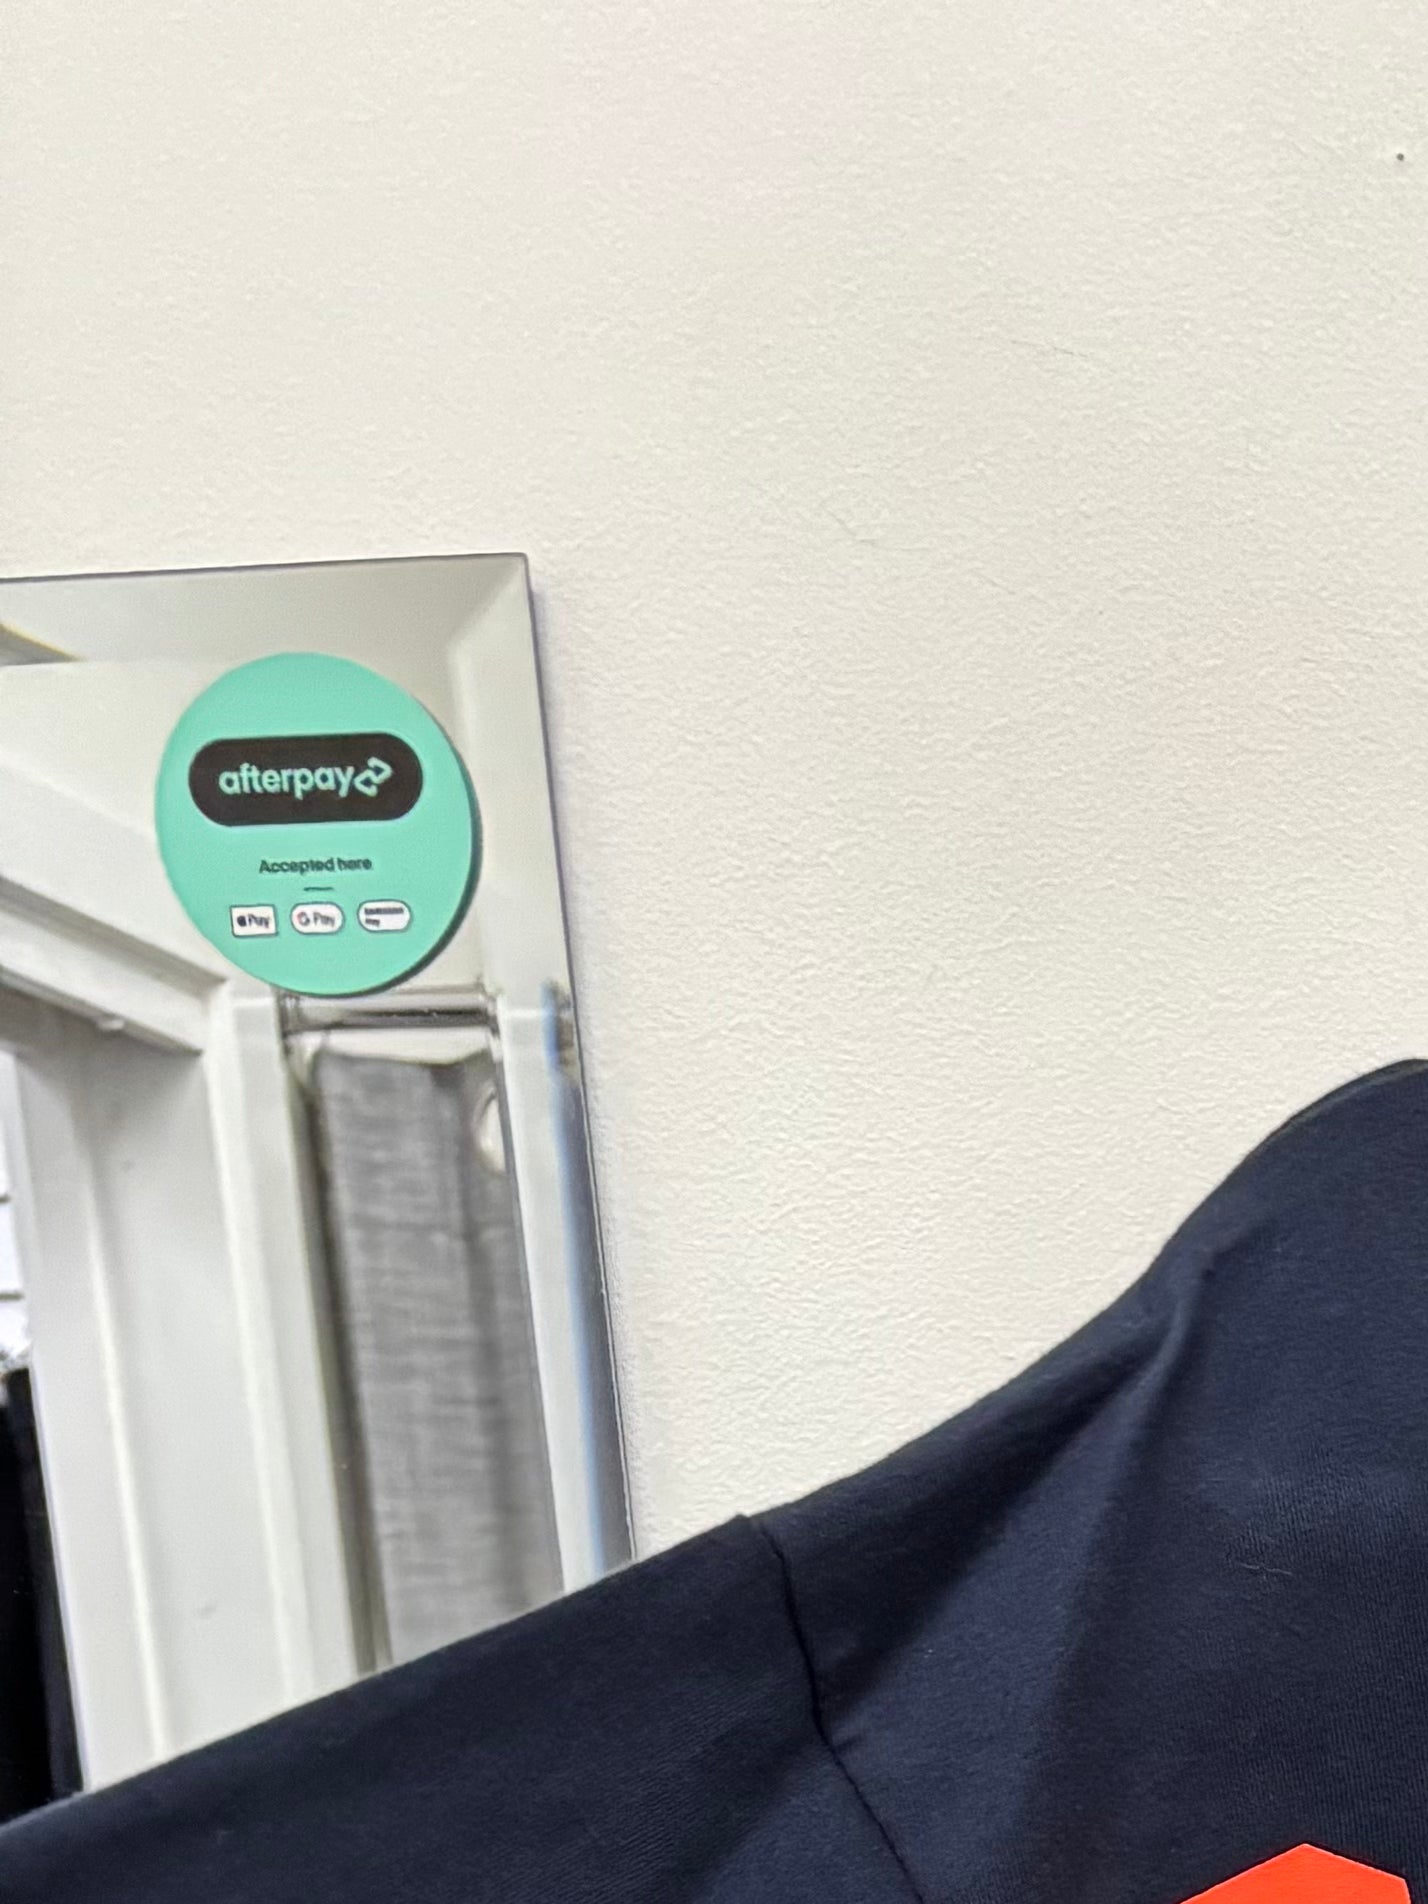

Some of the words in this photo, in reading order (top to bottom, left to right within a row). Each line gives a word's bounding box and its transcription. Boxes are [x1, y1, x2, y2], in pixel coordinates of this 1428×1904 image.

[218, 762, 354, 800] afterpay
[259, 857, 335, 876] Accepted
[337, 857, 373, 871] here
